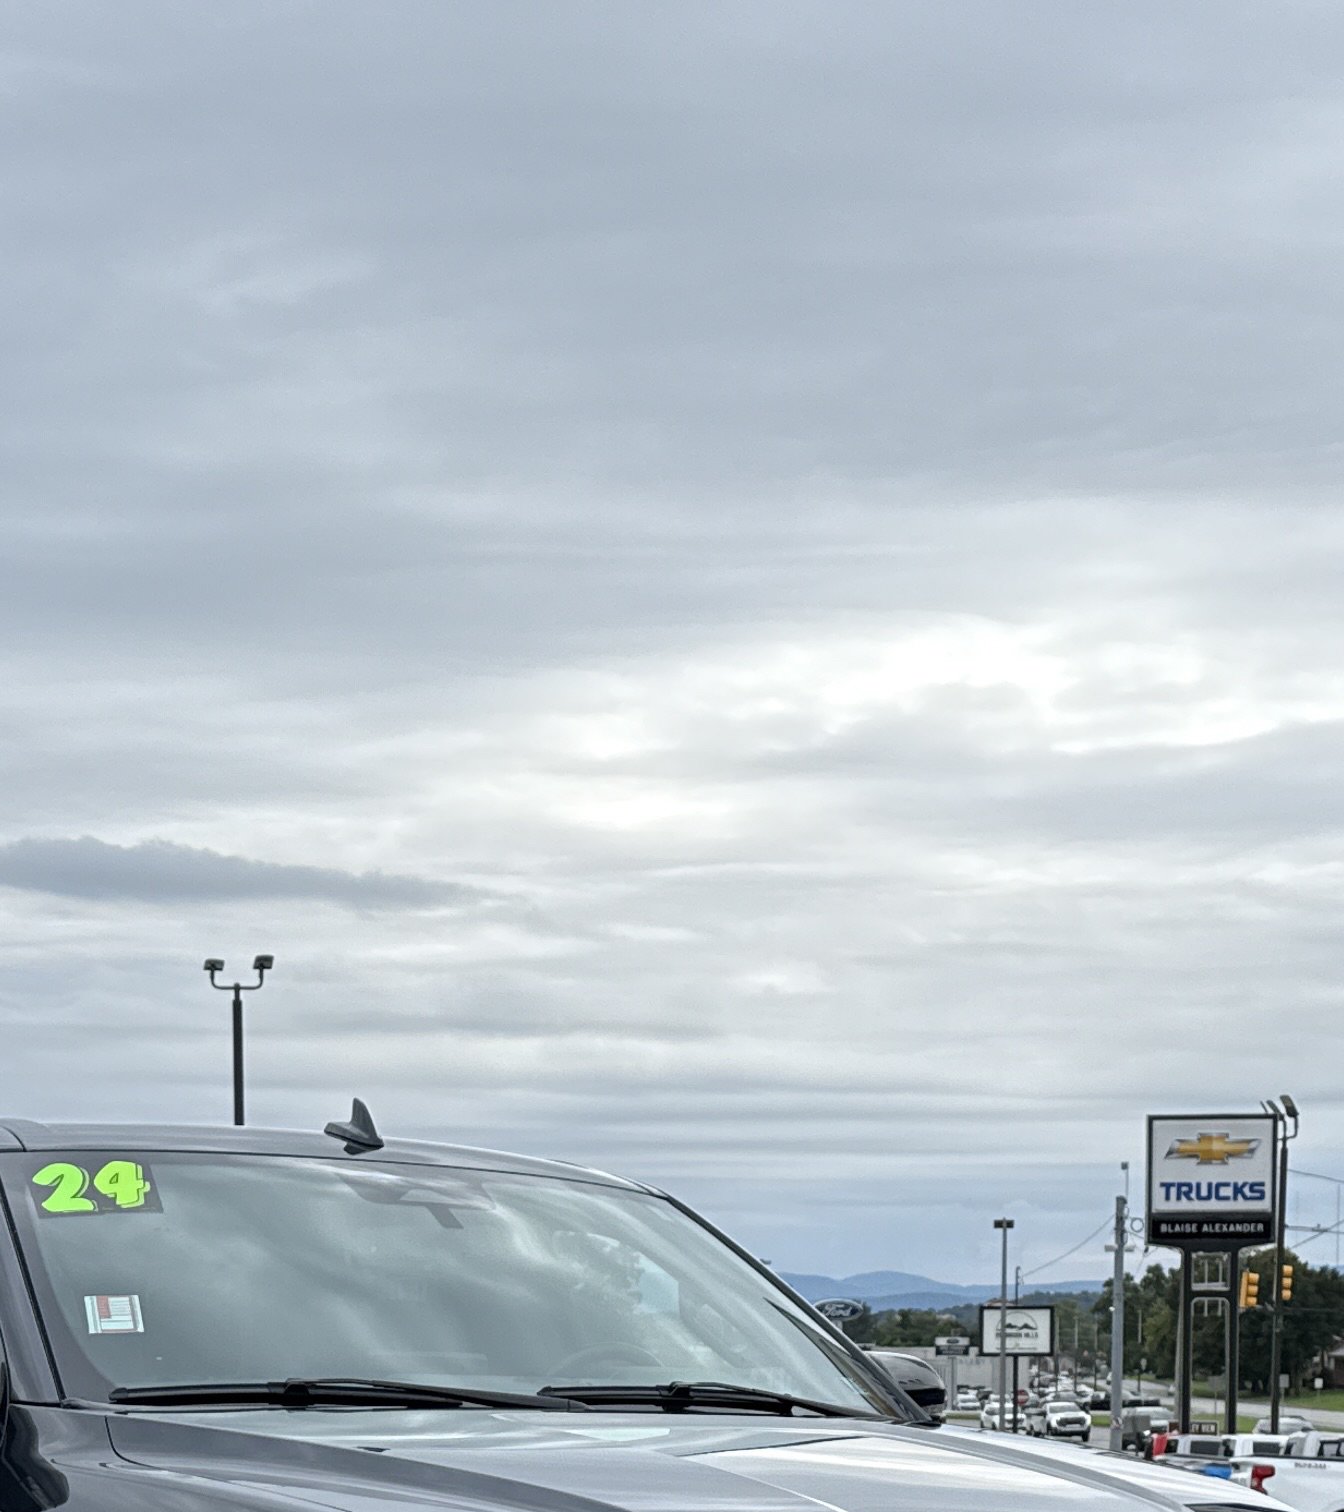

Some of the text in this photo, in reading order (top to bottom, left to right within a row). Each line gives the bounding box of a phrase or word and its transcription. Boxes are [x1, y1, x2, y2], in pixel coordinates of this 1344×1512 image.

[32, 1160, 151, 1213] 24
[1159, 1181, 1266, 1201] TRUCKS
[1160, 1222, 1265, 1233] BLAISE ALEXANDER
